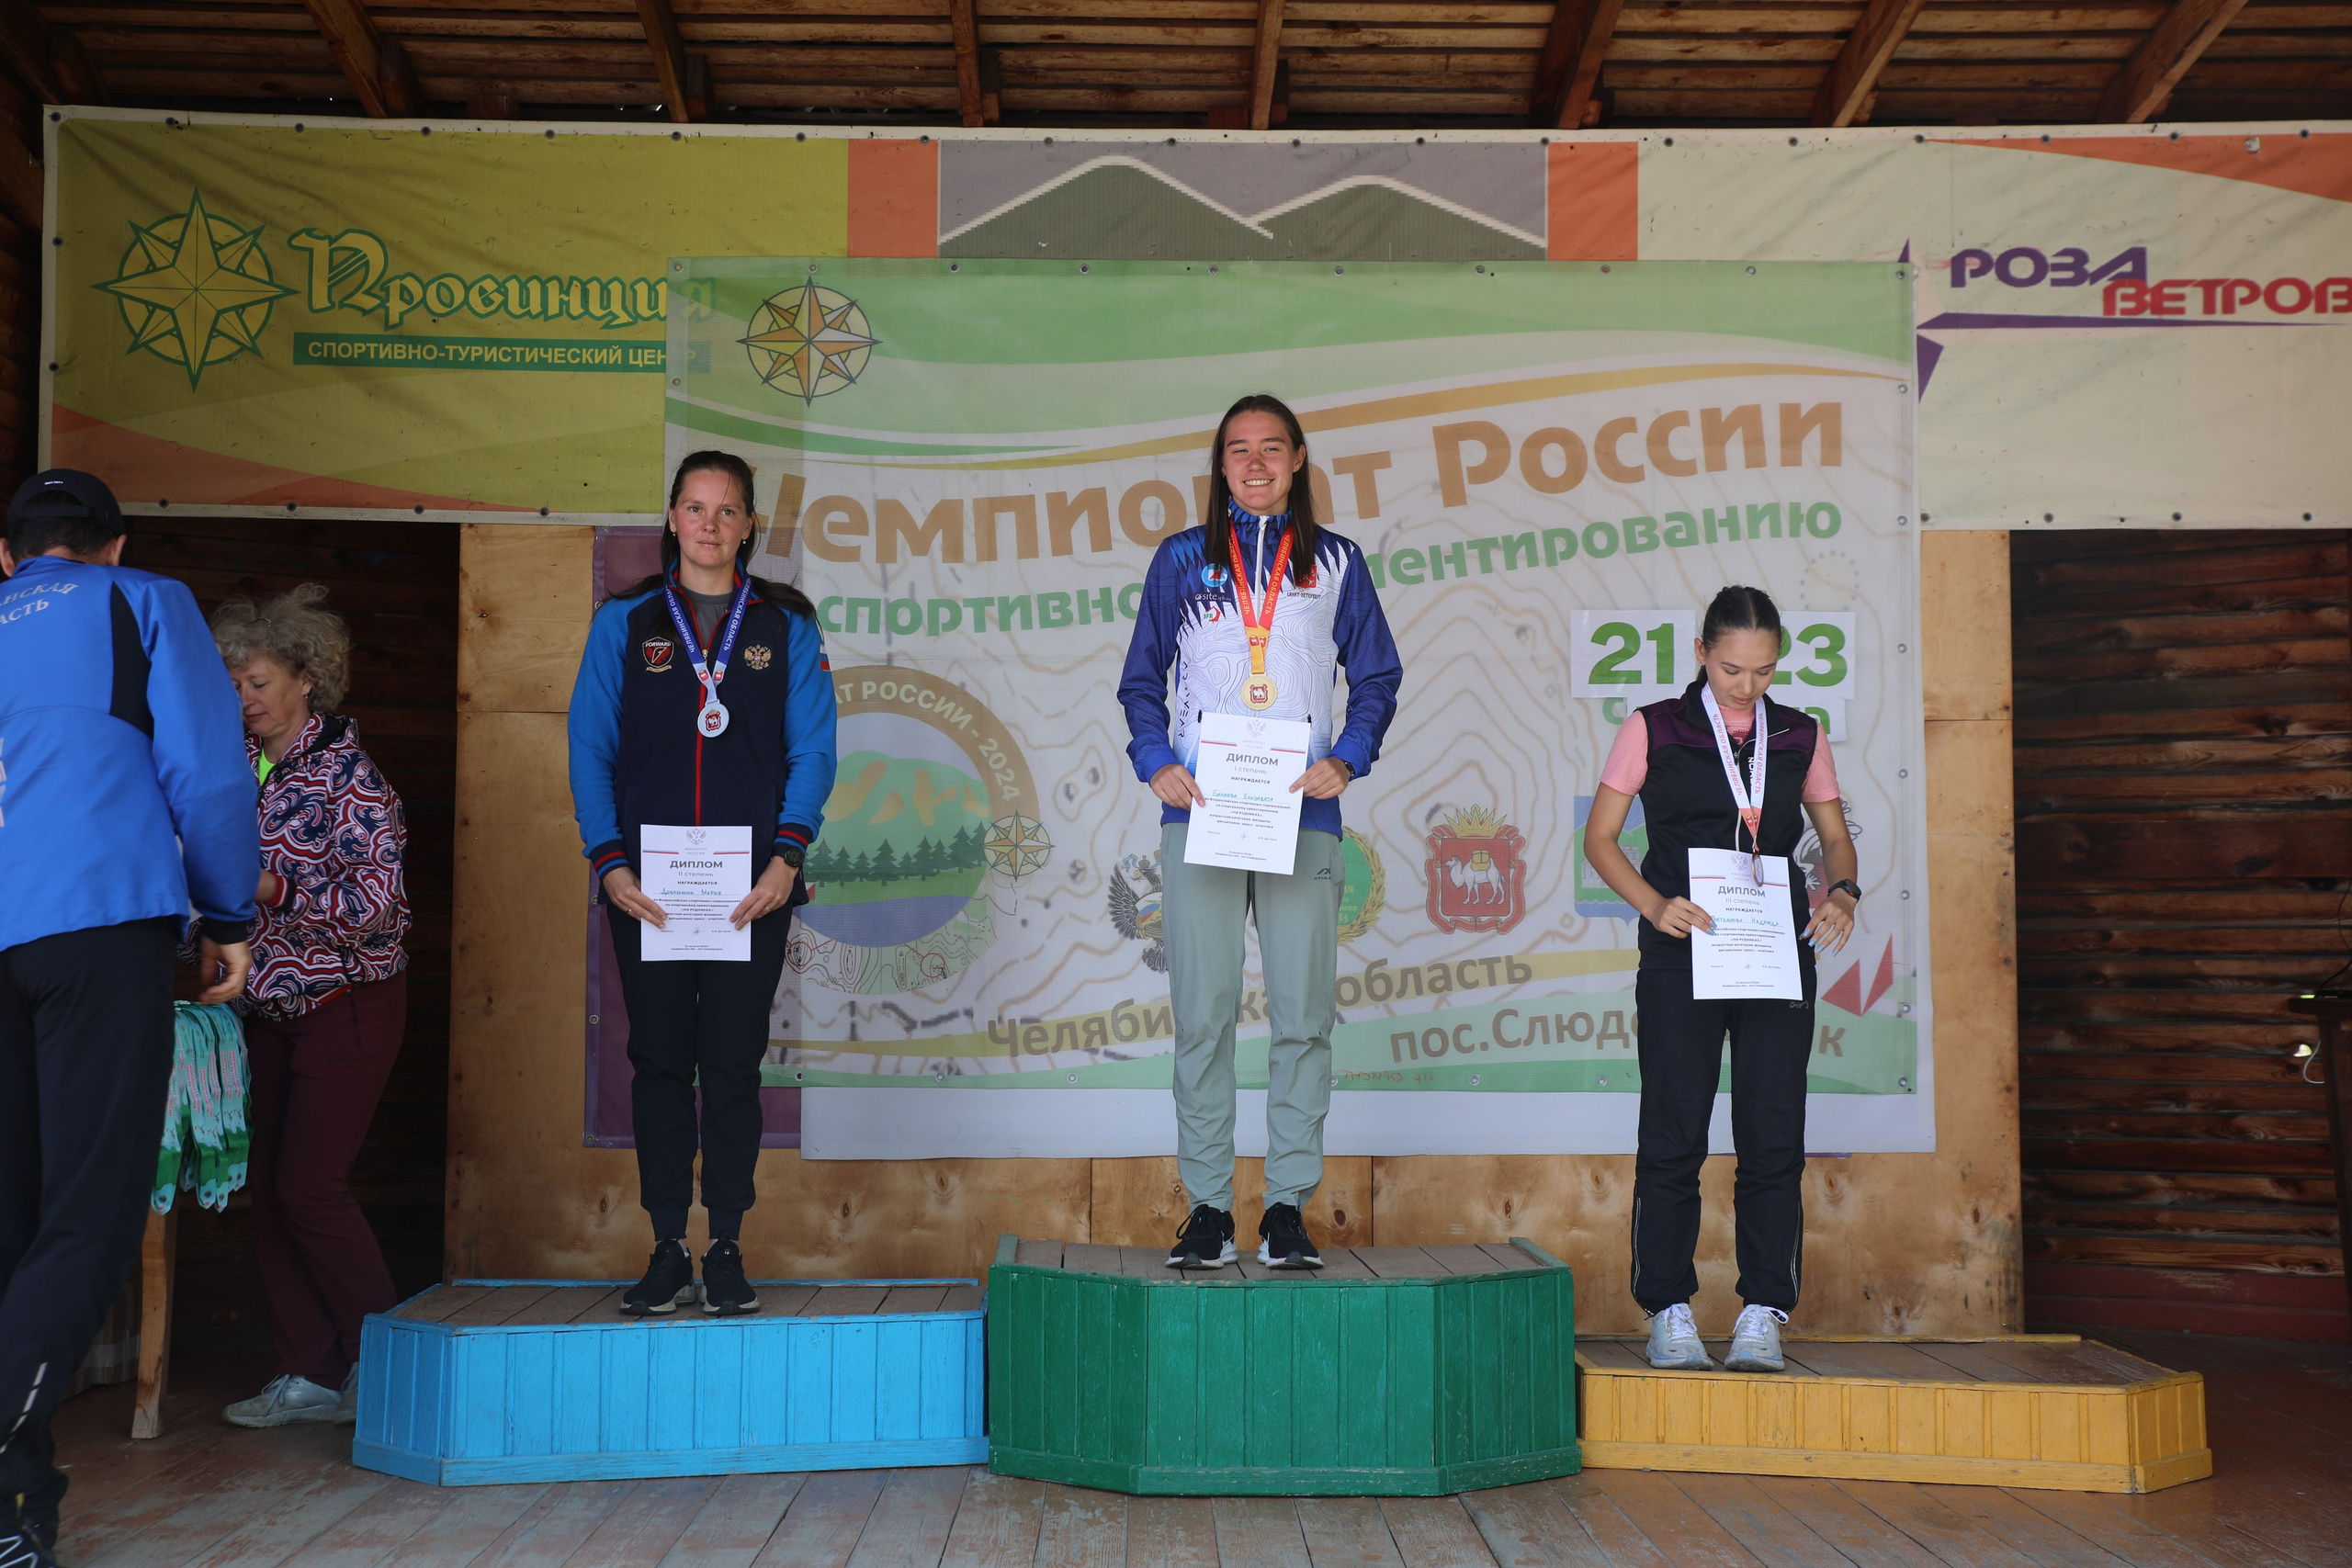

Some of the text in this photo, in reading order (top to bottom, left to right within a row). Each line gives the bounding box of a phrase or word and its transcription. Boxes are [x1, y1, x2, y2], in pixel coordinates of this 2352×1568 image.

[1950, 246, 2147, 288] РОЗА
[2103, 277, 2352, 317] ВЕТРОВ
[307, 340, 623, 366] СПОРТИВНО-ТУРИСТИЧЕСКИЙ
[1431, 401, 1842, 509] России
[1234, 563, 1250, 615] ЧЕЛЯБИНСКАЯ
[1264, 534, 1291, 615] ЧЕЛЯБИНСКАЯ ОБЛАСТЬ
[672, 606, 695, 653] ЧЕЛЯБИНСКАЯ
[724, 619, 739, 651] ОБЛАСТЬ
[1588, 621, 1675, 685] 21
[862, 681, 973, 730] РОССИИ
[978, 738, 1021, 801] 2024
[1713, 713, 1726, 744] ОБЛАСТЬ
[1226, 752, 1279, 766] ДИПЛОМ
[1722, 745, 1743, 796] ЧЕЛЯБИНСКАЯ
[1754, 713, 1765, 795] ЧЕЛЯБИНСКАЯ ОБЛАСТЬ
[670, 861, 723, 869] ДИПЛОМ
[1718, 886, 1766, 897] ДИПЛОМ
[1335, 953, 1532, 1007] область
